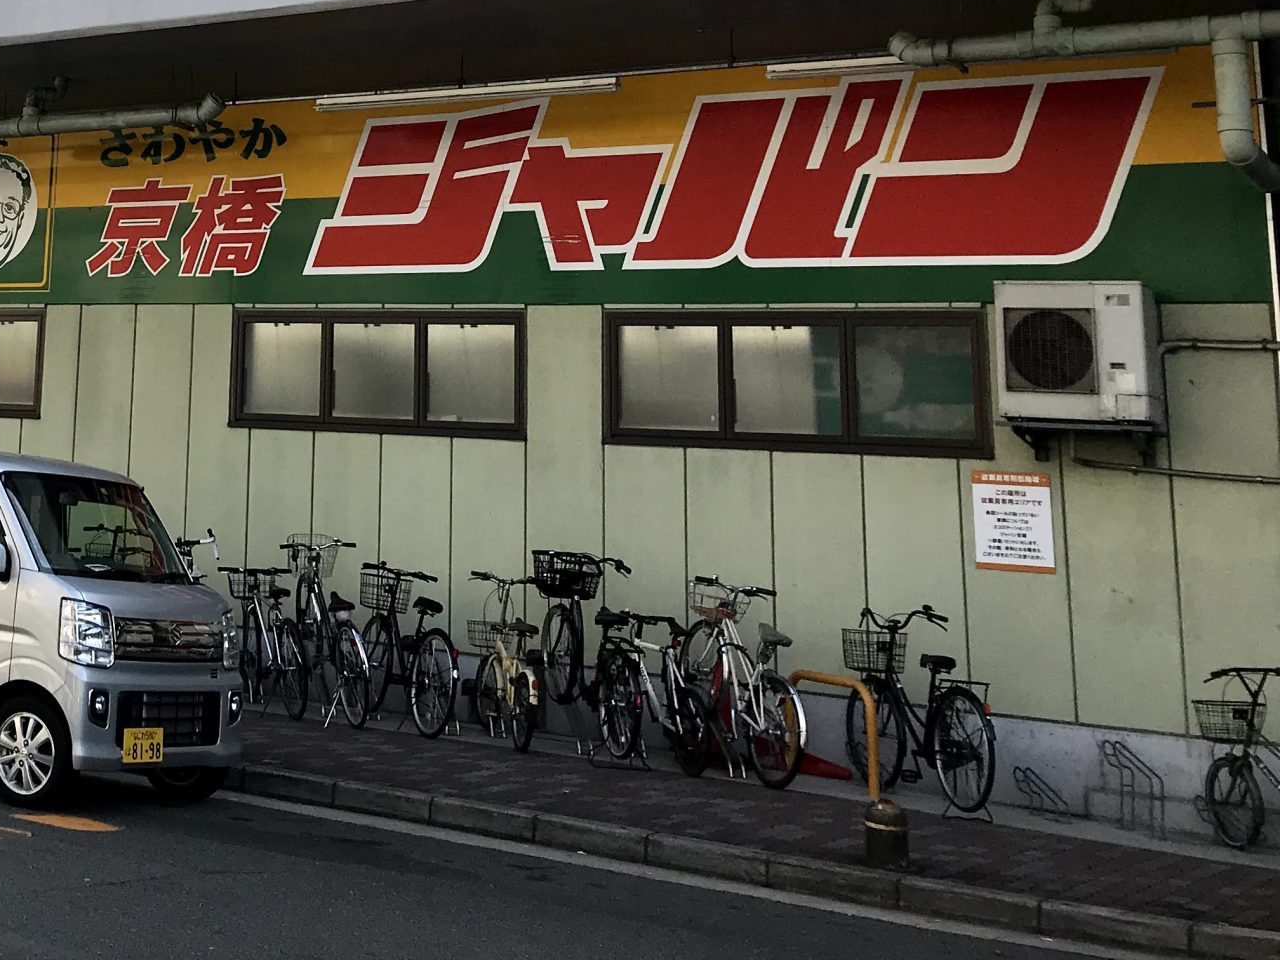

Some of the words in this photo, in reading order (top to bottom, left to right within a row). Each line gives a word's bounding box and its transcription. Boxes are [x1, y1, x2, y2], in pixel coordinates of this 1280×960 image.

[99, 118, 288, 168] さわやか
[85, 172, 288, 278] 京橋
[302, 65, 1167, 276] ジャパン
[132, 742, 162, 761] 81-98
